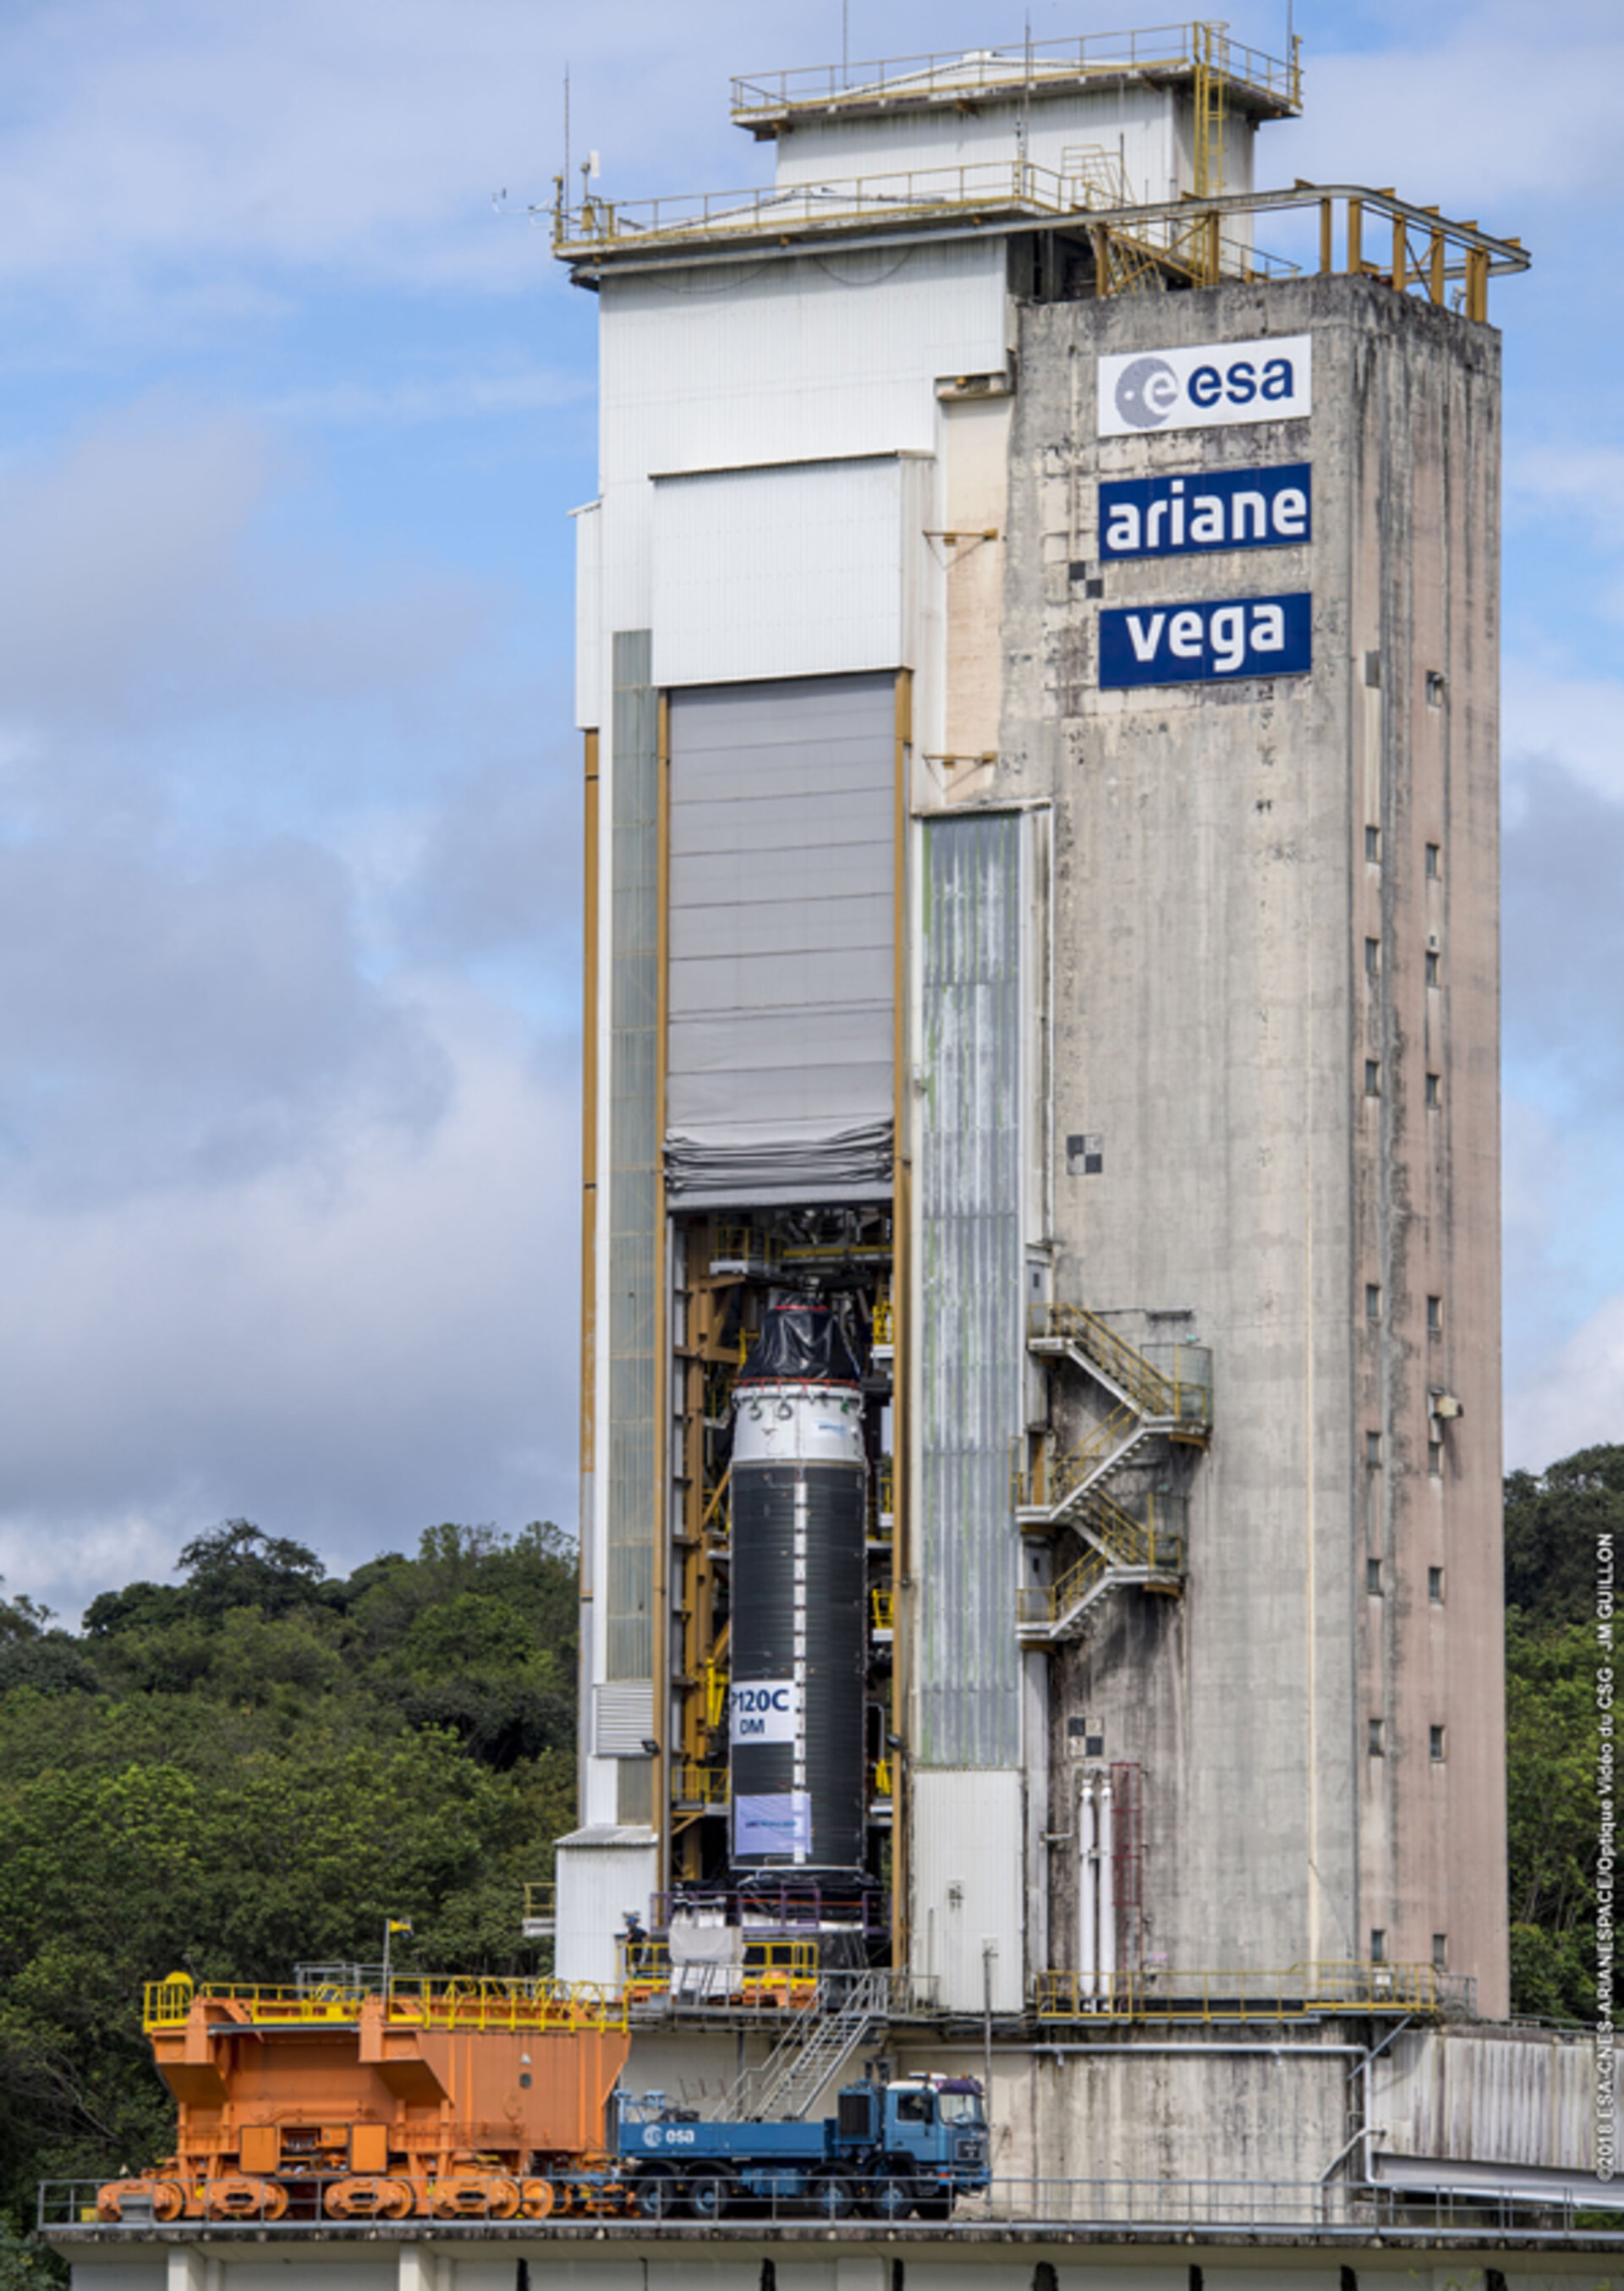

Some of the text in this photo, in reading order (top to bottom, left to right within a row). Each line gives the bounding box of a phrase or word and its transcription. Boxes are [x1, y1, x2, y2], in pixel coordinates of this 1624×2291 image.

[1188, 358, 1294, 408] esa
[1106, 479, 1307, 551] ariane
[1126, 603, 1284, 672] vega
[740, 1719, 765, 1734] DM
